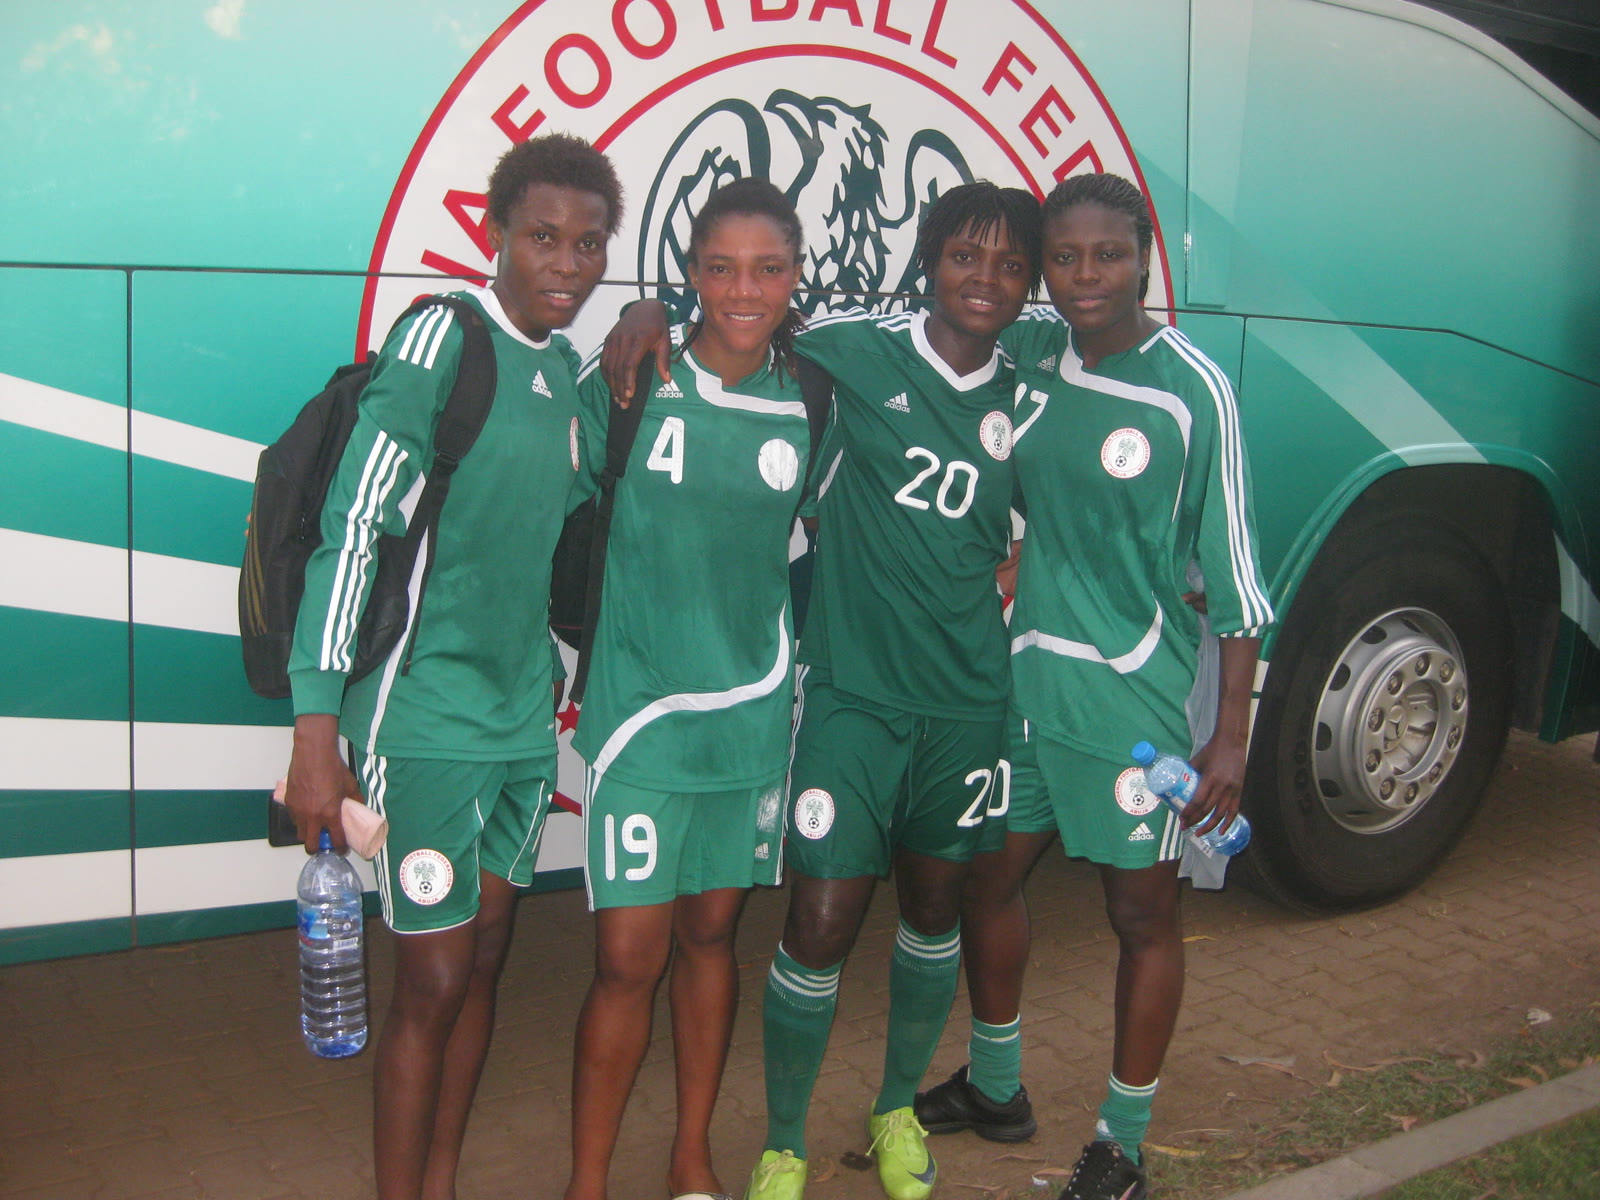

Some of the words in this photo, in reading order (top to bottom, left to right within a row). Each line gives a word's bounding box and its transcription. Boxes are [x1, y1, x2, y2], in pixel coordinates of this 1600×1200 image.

[655, 391, 684, 399] adidas
[883, 400, 911, 414] adidas
[1111, 429, 1139, 438] FOOTBALL
[646, 416, 685, 484] 4
[894, 446, 979, 519] 20
[1119, 767, 1143, 780] FOOTBAL
[957, 758, 1011, 827] 20
[604, 813, 659, 881] 19
[1127, 832, 1155, 842] adidas
[404, 851, 432, 865] FOOTBALL
[433, 852, 453, 888] FEDERATION
